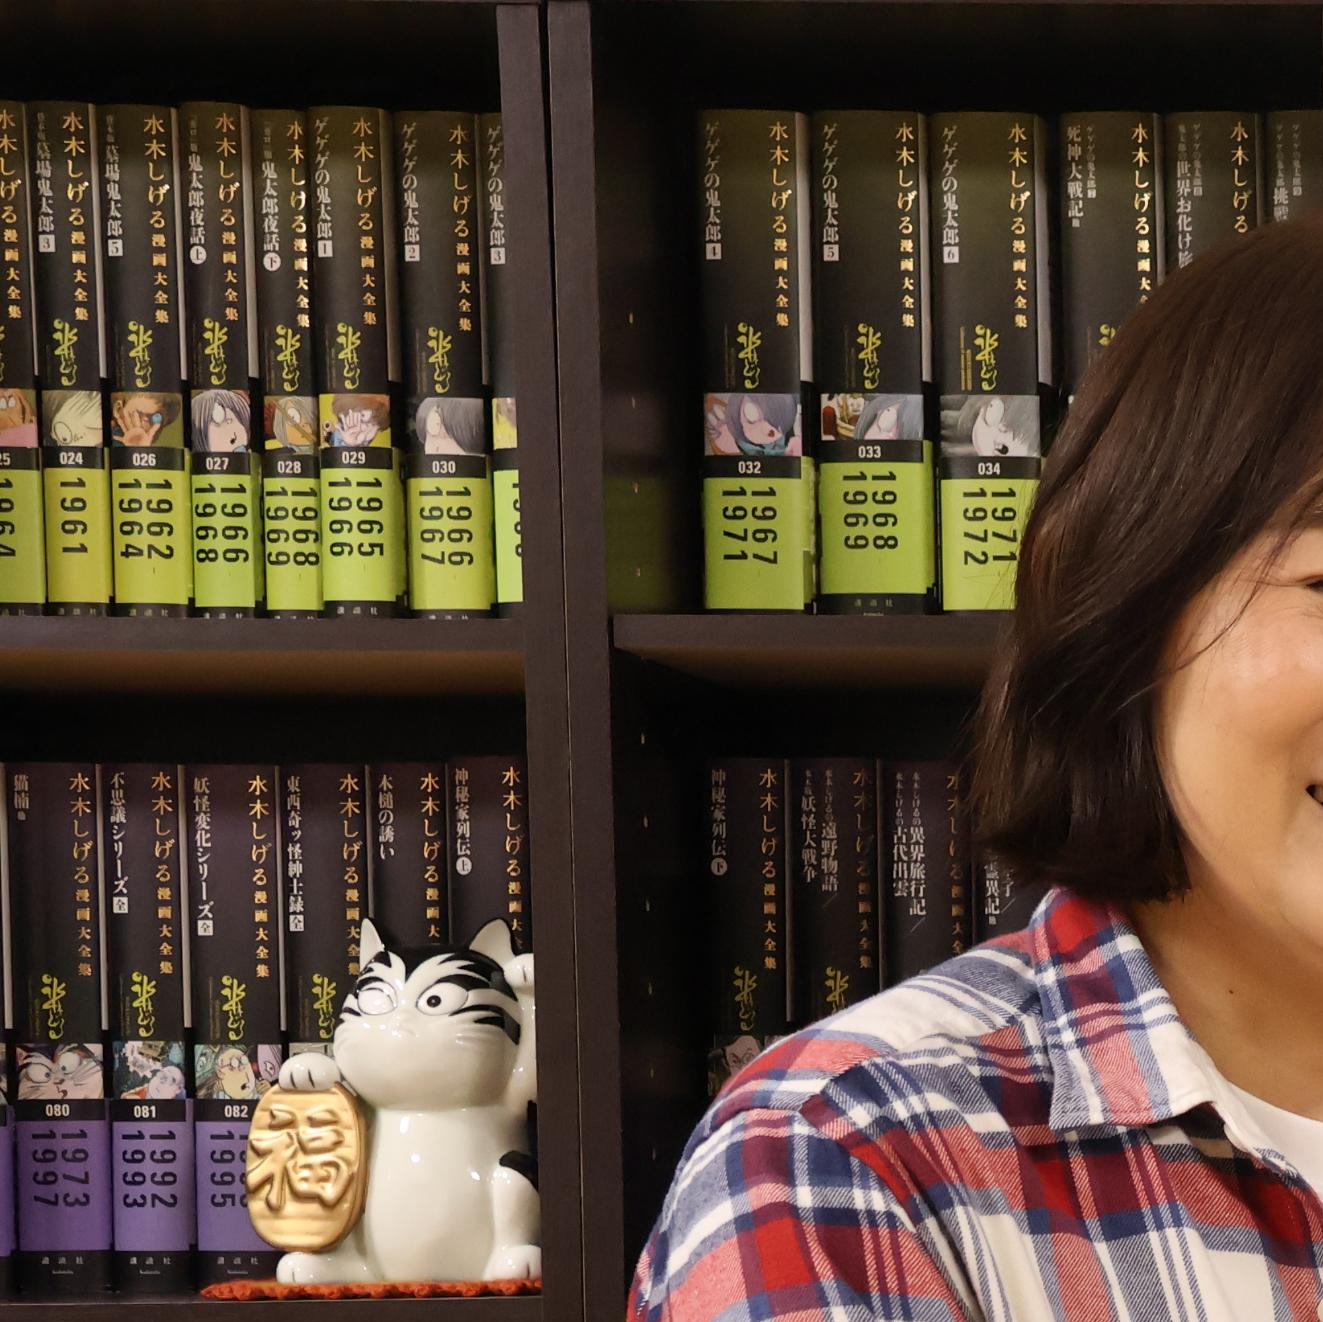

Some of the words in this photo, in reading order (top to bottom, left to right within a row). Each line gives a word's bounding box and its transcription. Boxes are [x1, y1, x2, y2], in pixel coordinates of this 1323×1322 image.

[60, 452, 83, 465] 024
[133, 454, 156, 467] 026
[206, 458, 229, 471] 027
[342, 451, 366, 465] 029
[432, 460, 456, 474] 030
[738, 461, 760, 474] 032
[858, 446, 881, 458] 033
[978, 462, 1000, 475] 034
[60, 479, 88, 555] 1961
[119, 479, 145, 558] 1964
[146, 479, 174, 560] 1962
[358, 477, 384, 557] 1965
[419, 487, 444, 566] 1967
[446, 487, 473, 566] 1966
[751, 486, 777, 565] 1967
[872, 471, 898, 549] 1968
[963, 486, 988, 565] 1972
[992, 486, 1017, 565] 1971
[46, 1105, 70, 1117] 080
[134, 1106, 156, 1118] 081
[224, 1105, 248, 1118] 082
[32, 1130, 58, 1206] 1997
[61, 1130, 89, 1206] 1973
[122, 1132, 146, 1208] 1993
[150, 1132, 177, 1207] 1992
[247, 1110, 357, 1213] 福
